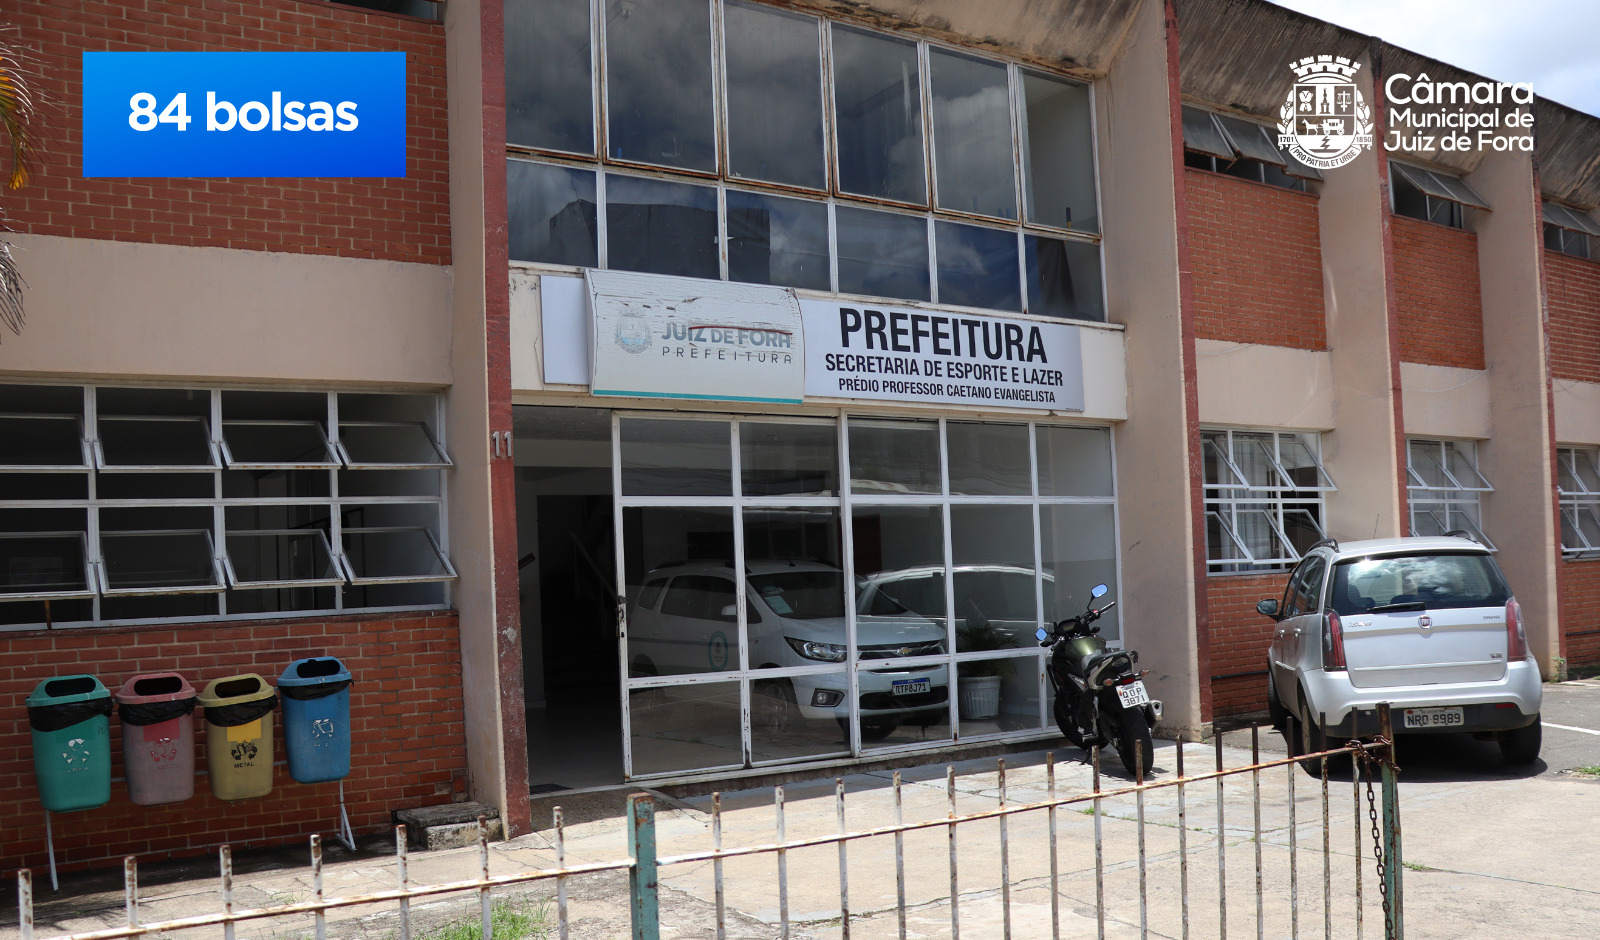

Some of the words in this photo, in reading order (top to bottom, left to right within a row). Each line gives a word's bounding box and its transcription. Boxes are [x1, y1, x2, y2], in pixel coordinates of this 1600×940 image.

[661, 322, 707, 342] JUIZ
[711, 328, 735, 344] DE
[738, 329, 791, 348] FORA
[839, 307, 1048, 363] PREFEITURA
[662, 346, 792, 364] PREFEITURA
[825, 353, 920, 376] SECRETARIA
[924, 360, 943, 377] DE
[946, 361, 1007, 382] ESPORTE
[1011, 367, 1019, 383] E
[1023, 368, 1063, 387] LAZER
[838, 375, 878, 392] PRÉDIO
[882, 382, 944, 396] PROFESSOR
[946, 385, 992, 399] CAETANO
[994, 388, 1056, 403] EVANGELISTA
[492, 431, 512, 457] 11
[1124, 694, 1146, 706] 3871
